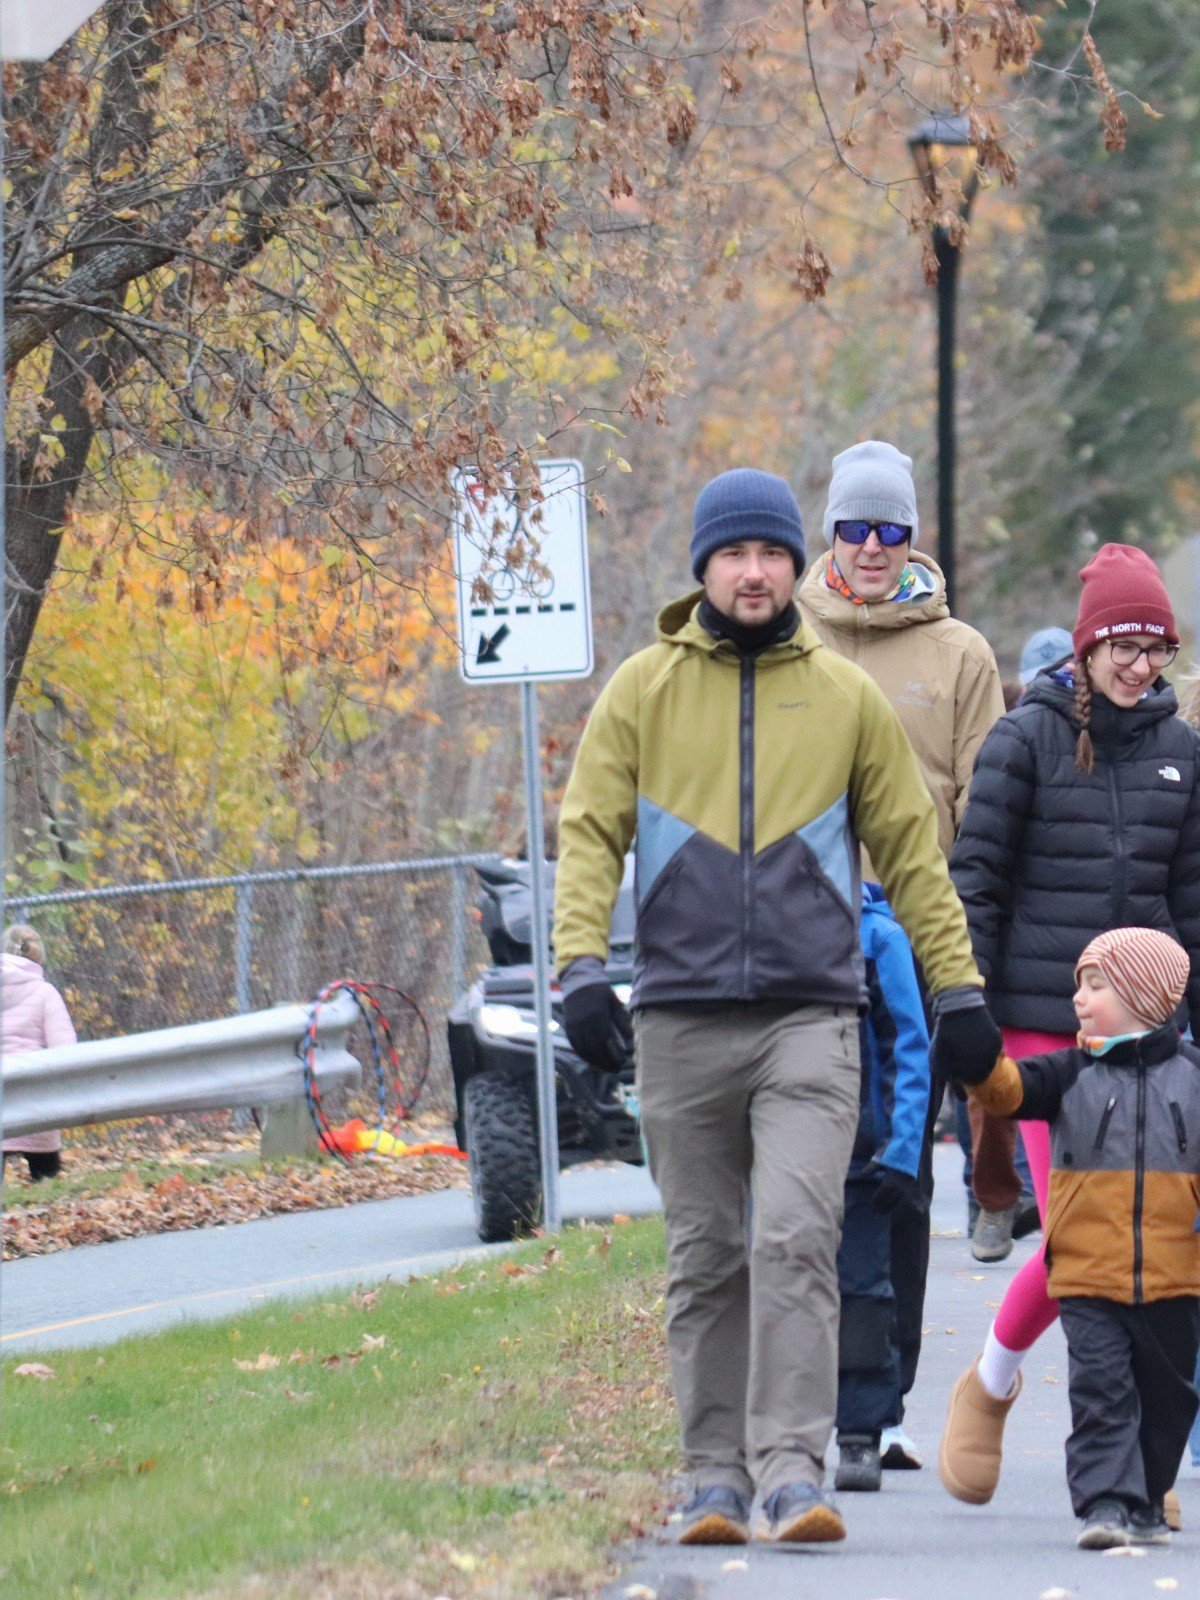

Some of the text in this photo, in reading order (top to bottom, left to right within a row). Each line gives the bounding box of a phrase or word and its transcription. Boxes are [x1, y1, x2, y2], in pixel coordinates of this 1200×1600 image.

[1094, 622, 1166, 639] THE NORTH FACE
